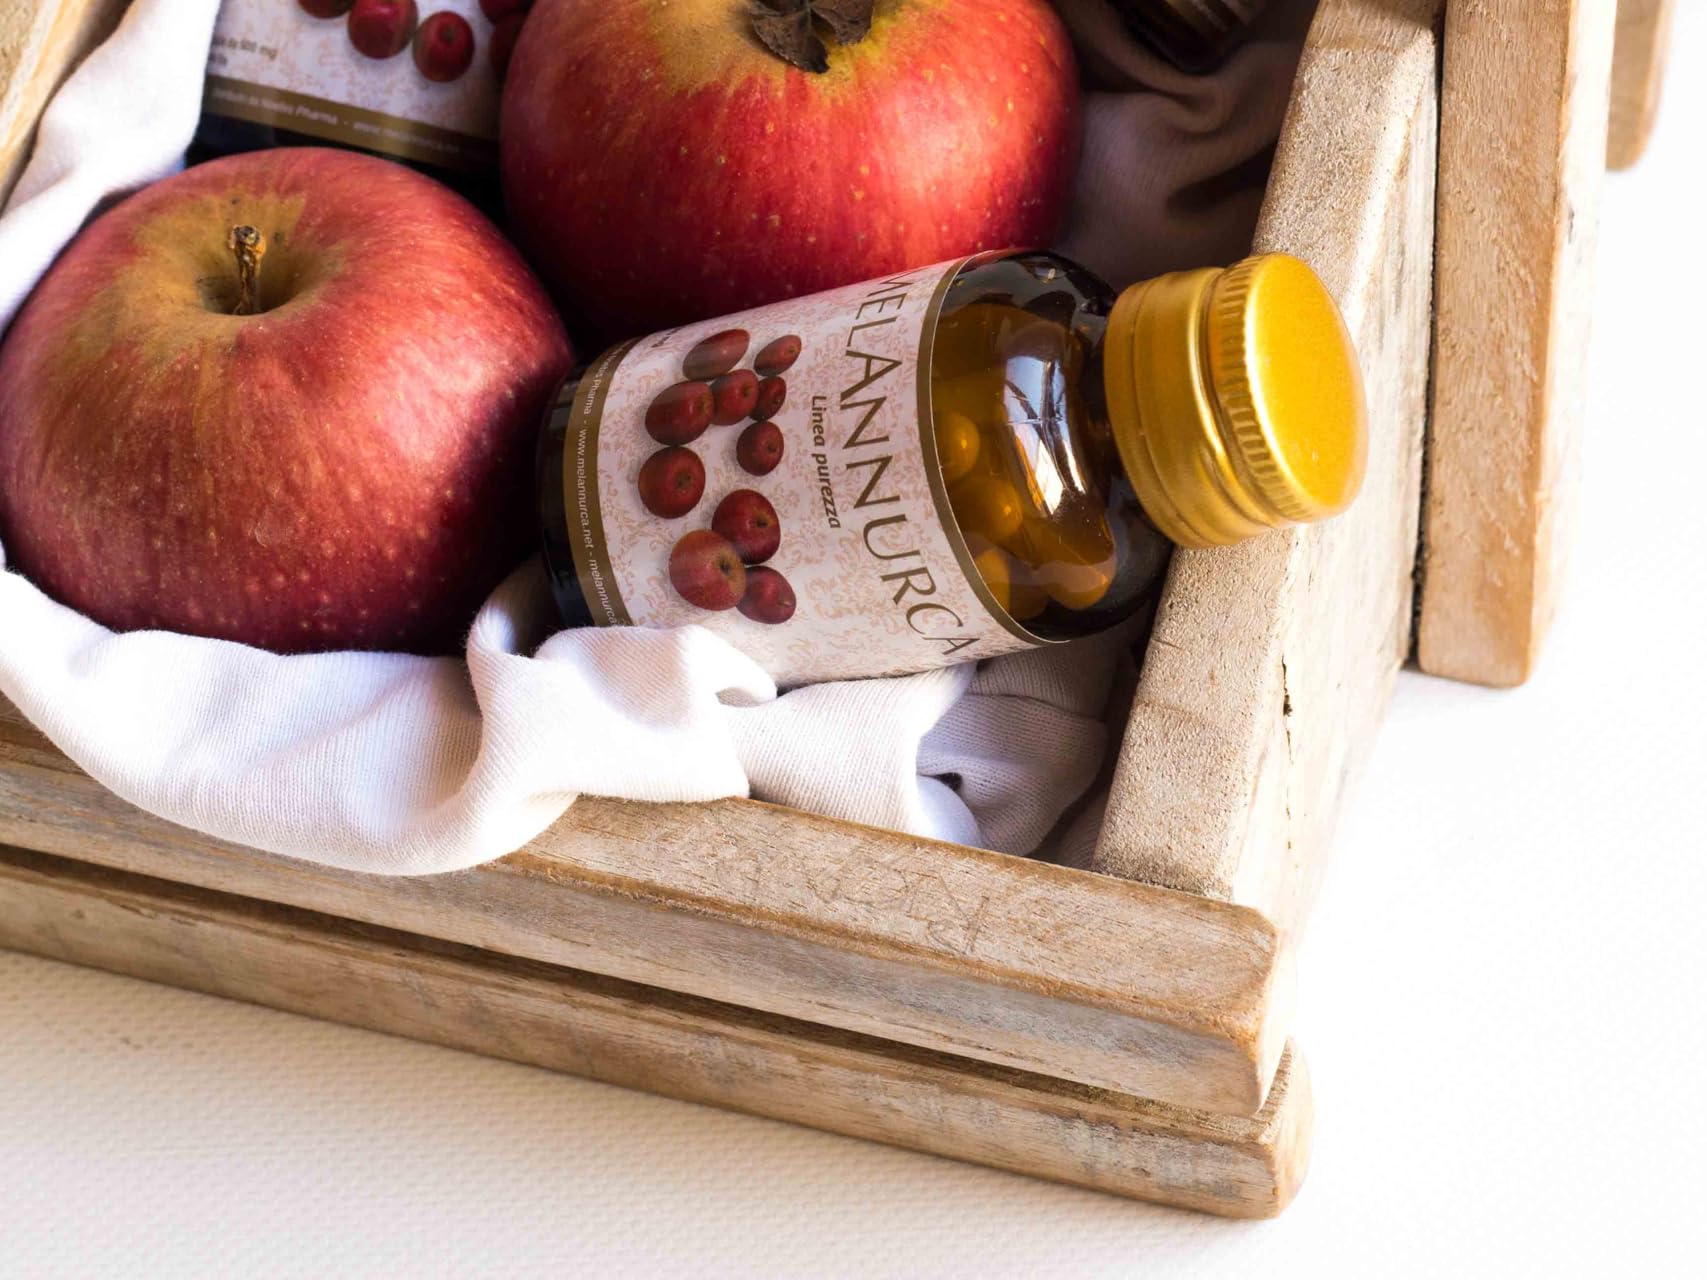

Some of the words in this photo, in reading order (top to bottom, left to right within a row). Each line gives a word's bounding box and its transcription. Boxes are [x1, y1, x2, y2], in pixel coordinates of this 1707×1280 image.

[811, 395, 827, 447] Linea
[839, 267, 981, 656] MELANNURCA
[577, 428, 595, 549] www.melannurca.net
[588, 558, 624, 624] melannurca
[811, 453, 841, 528] purezza
